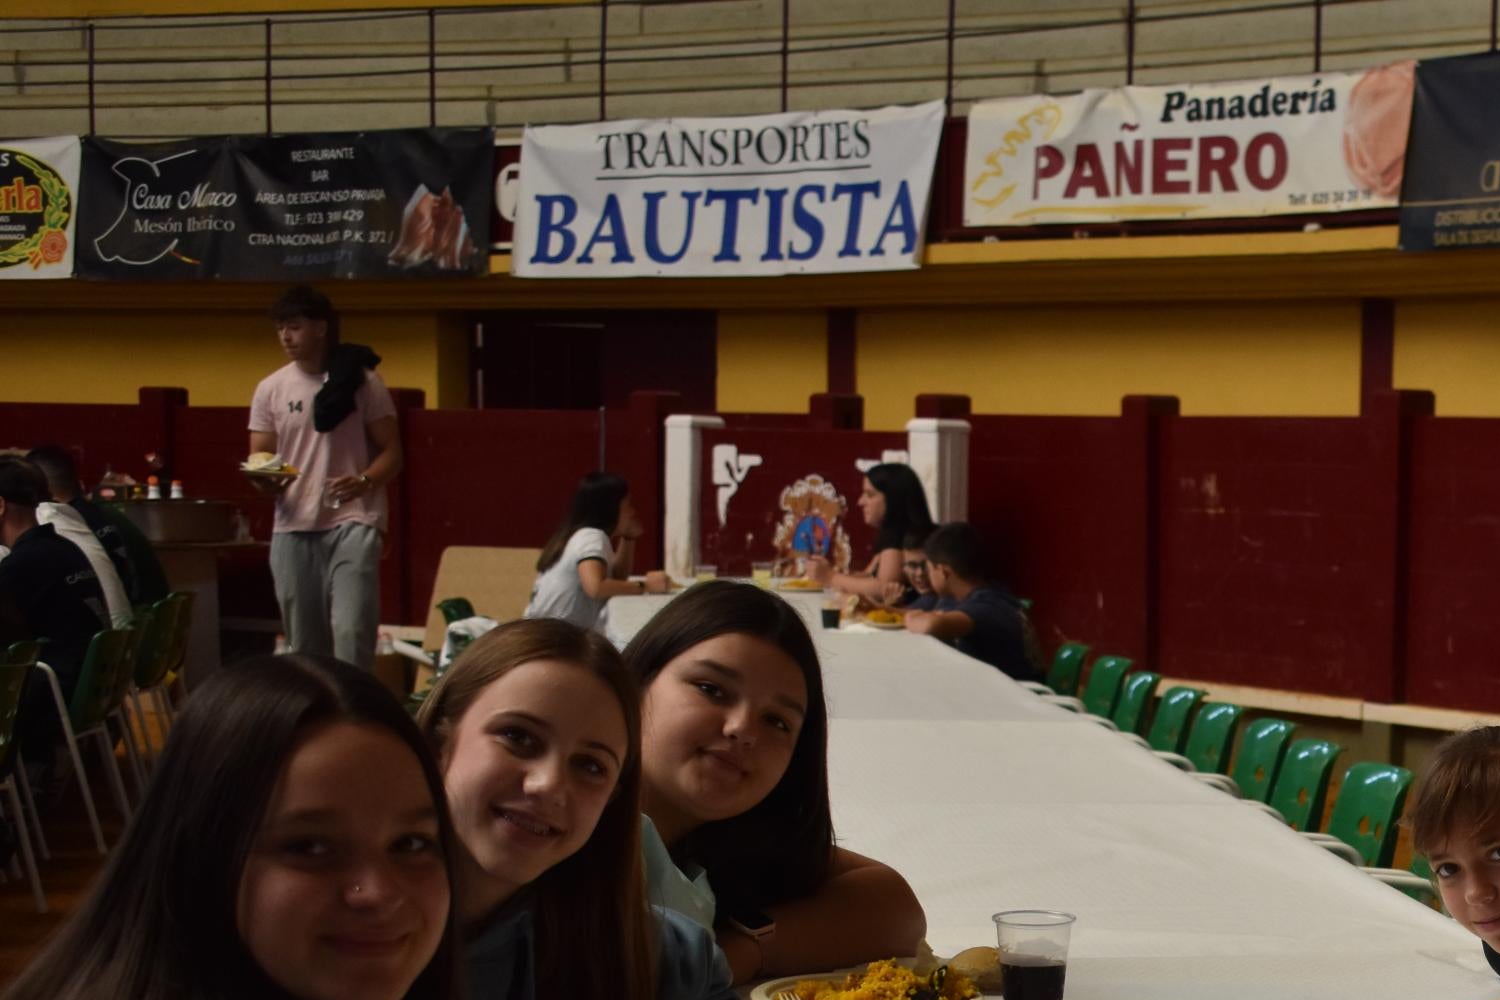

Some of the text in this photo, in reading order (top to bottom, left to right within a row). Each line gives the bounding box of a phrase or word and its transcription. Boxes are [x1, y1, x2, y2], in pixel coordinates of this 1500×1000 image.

[1160, 80, 1336, 122] Panadería
[291, 147, 355, 162] RESTAURANTE
[598, 119, 871, 169] TRANSPORTES
[1032, 123, 1288, 200] PAÑERO
[132, 183, 173, 210] Casa
[133, 217, 183, 233] Mesón
[530, 180, 920, 264] BAUTISTA
[287, 399, 303, 413] 14
